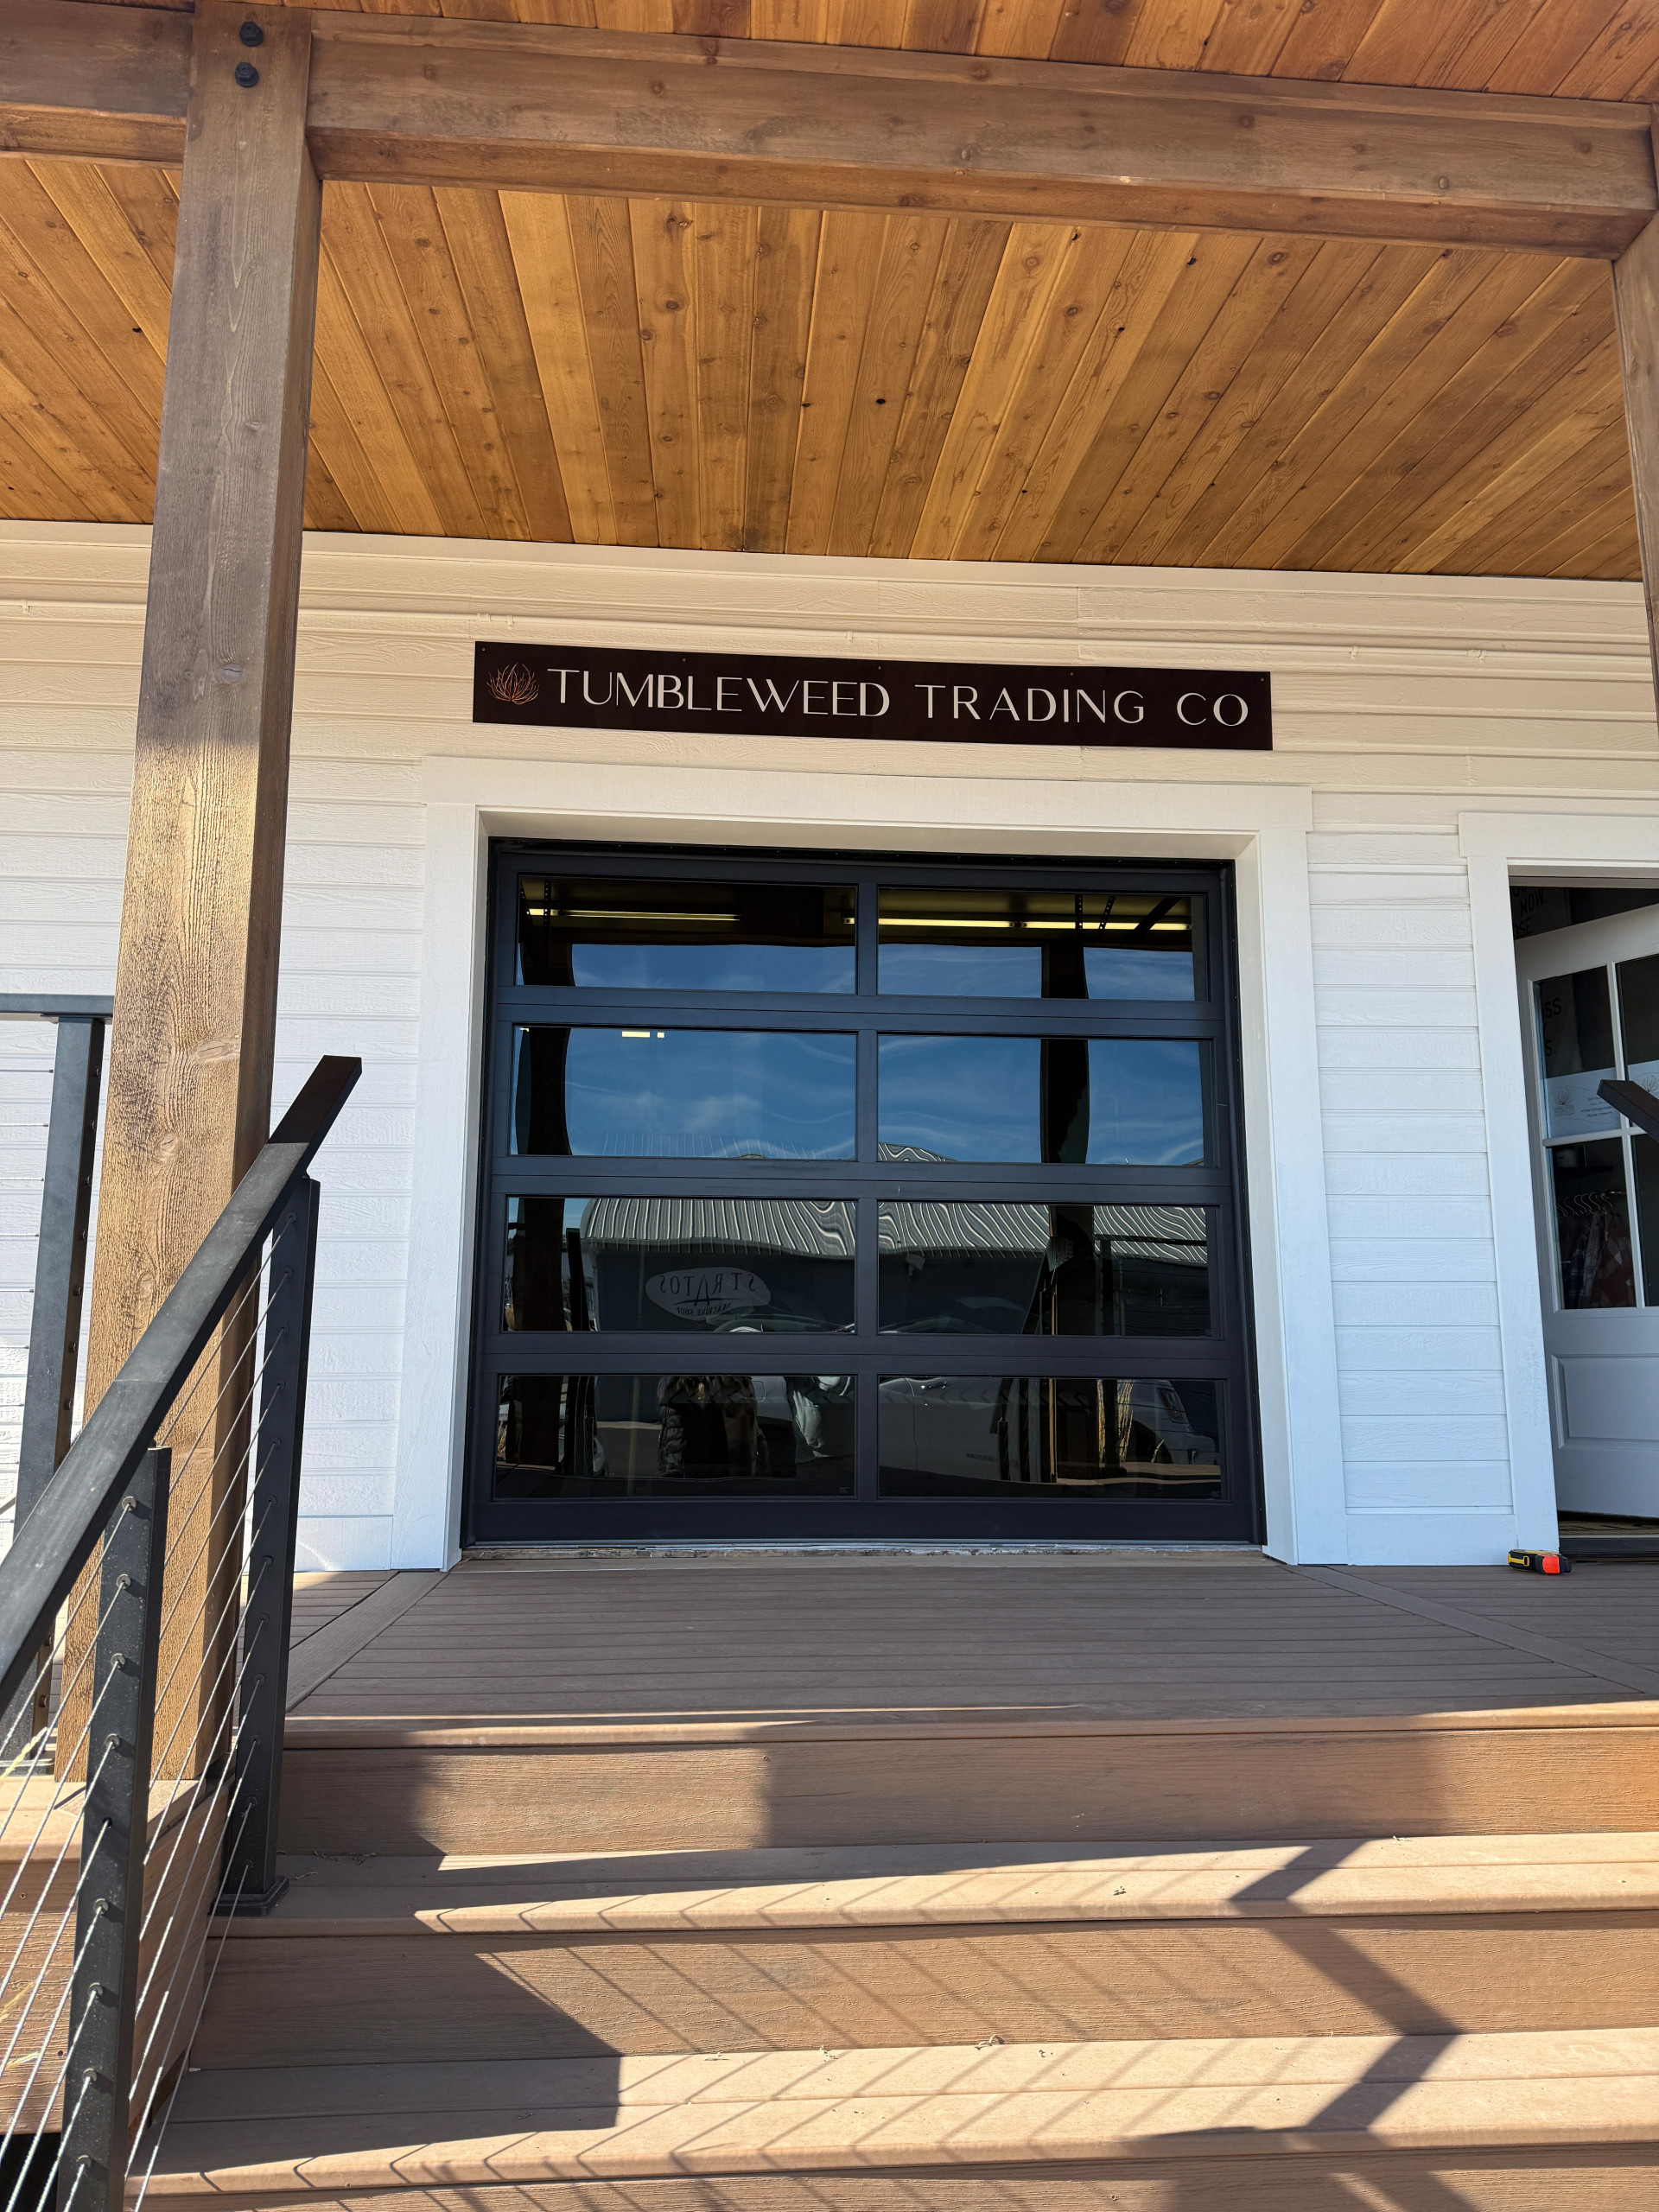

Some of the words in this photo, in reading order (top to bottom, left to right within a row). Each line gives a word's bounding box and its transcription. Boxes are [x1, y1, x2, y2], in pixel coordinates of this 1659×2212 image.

[546, 668, 891, 717] TUMBLEWEED
[914, 683, 1145, 724] TRADING
[1176, 692, 1249, 727] CO
